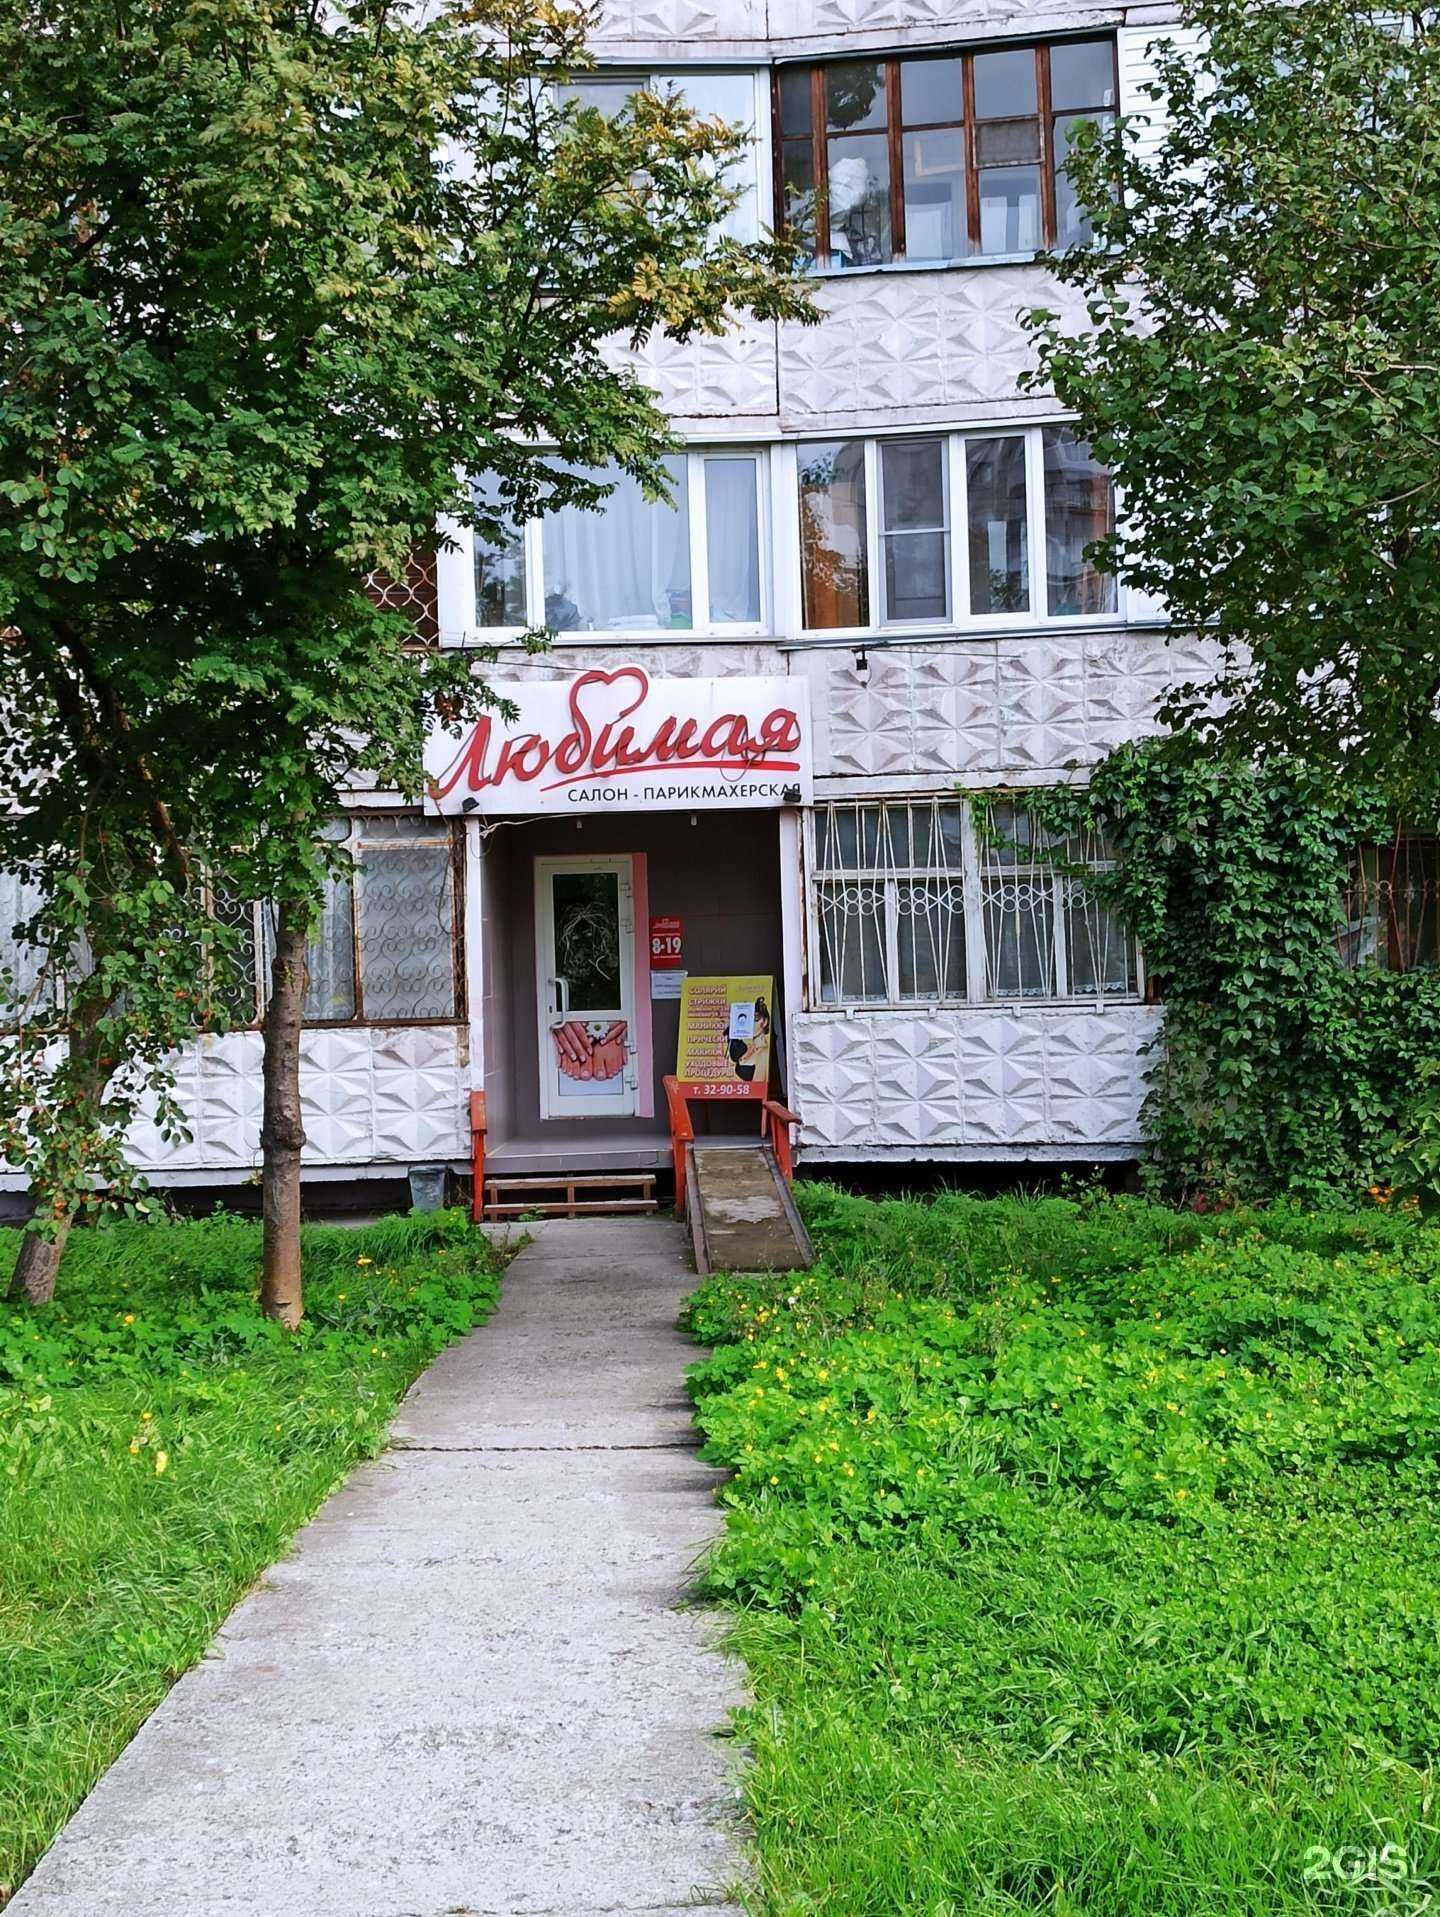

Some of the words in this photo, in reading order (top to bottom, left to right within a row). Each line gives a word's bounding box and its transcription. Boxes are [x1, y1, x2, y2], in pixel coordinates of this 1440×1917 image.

[428, 667, 801, 799] Любимая
[567, 787, 628, 802] САЛОН
[703, 1084, 750, 1095] 32-90-58
